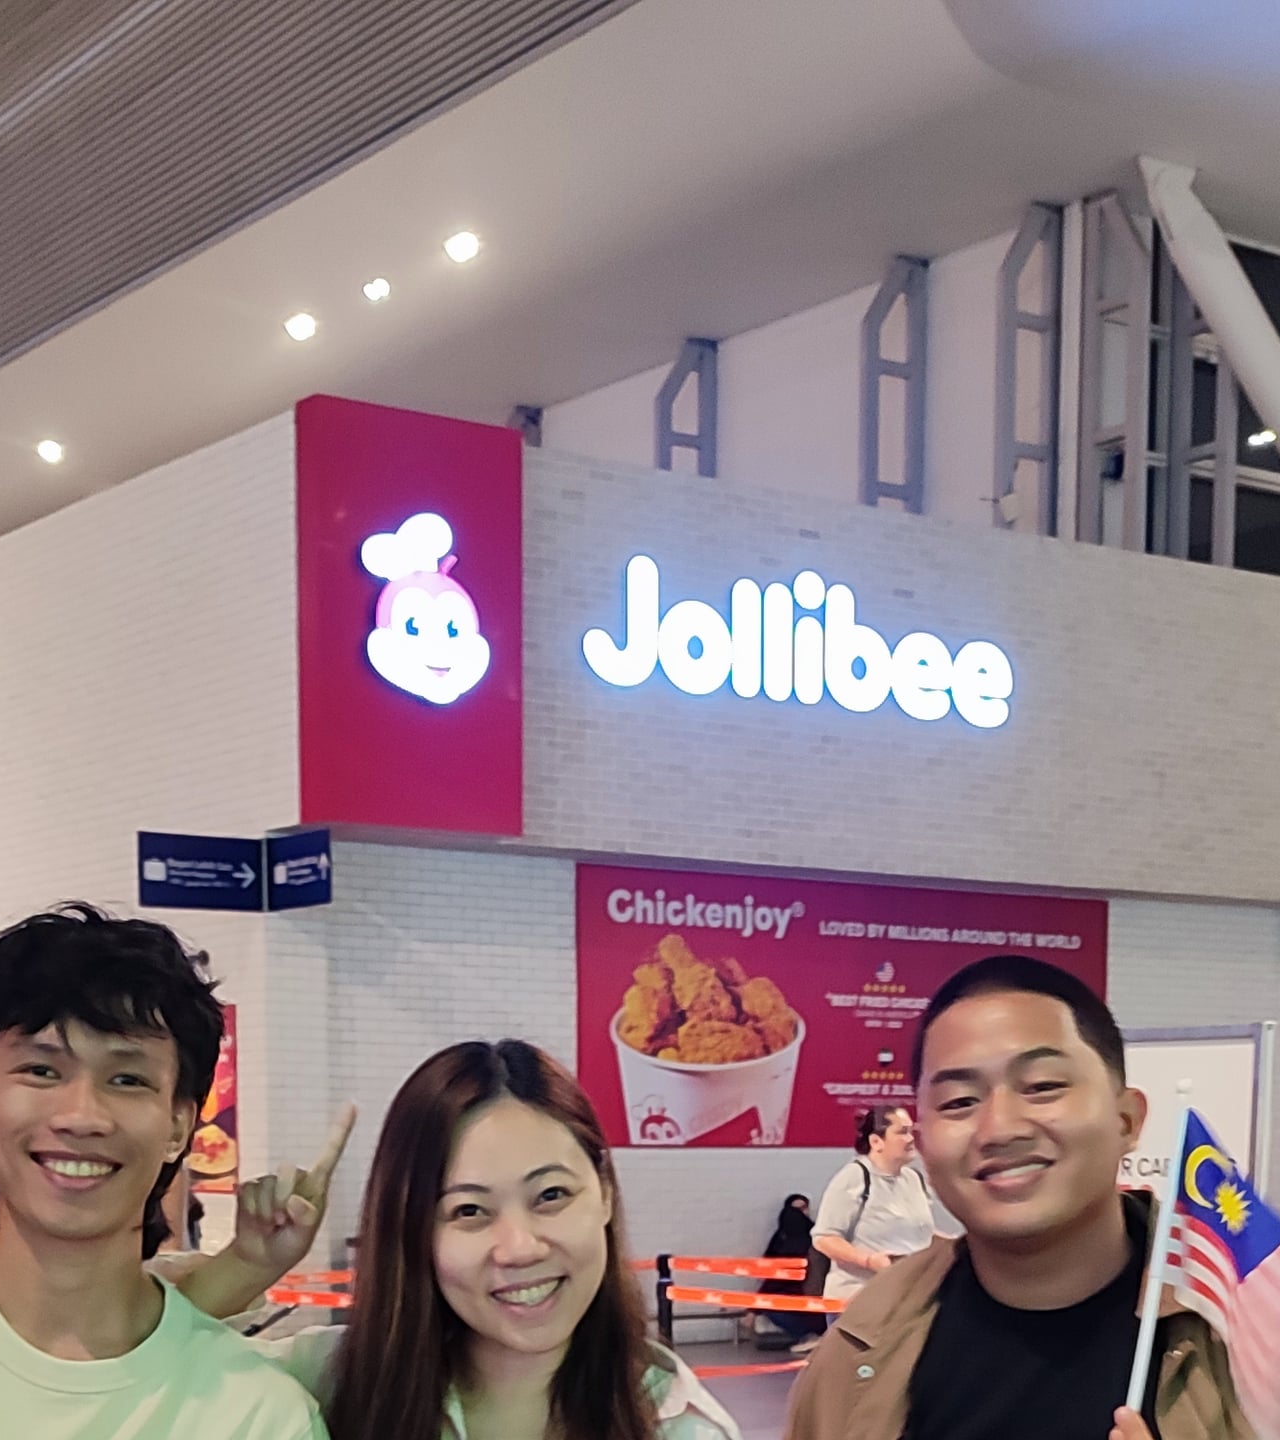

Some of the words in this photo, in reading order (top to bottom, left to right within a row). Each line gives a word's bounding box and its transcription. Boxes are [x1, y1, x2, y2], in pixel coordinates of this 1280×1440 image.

[581, 554, 1014, 729] Jollibee
[819, 920, 866, 937] LOVED
[867, 923, 887, 938] BY
[888, 924, 950, 942] MILLIONS
[951, 928, 1007, 946] AROUND
[1007, 931, 1033, 947] THE
[1035, 933, 1081, 950] WORLD
